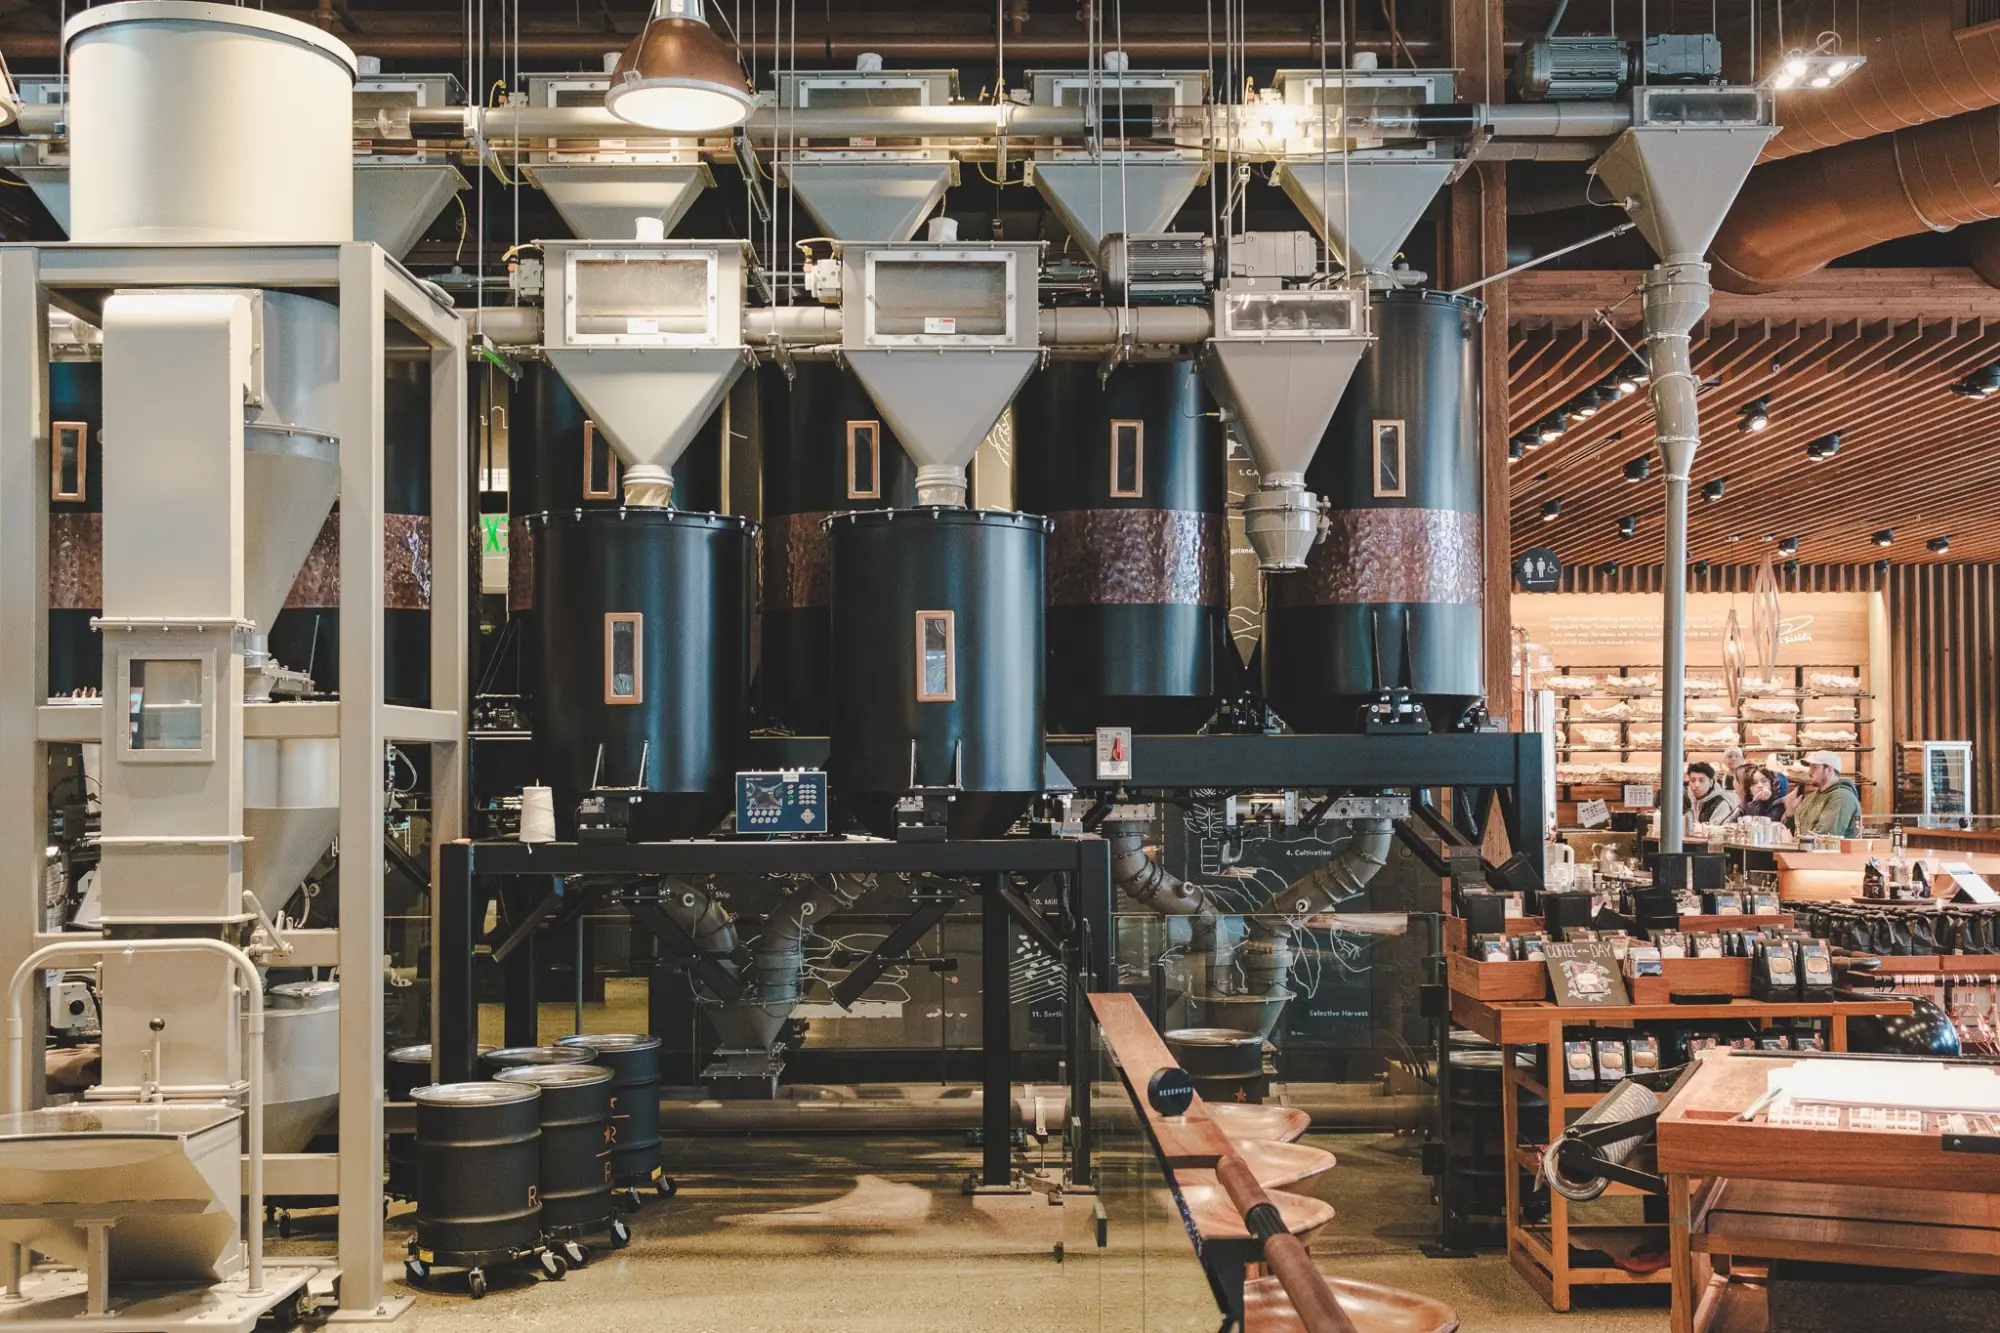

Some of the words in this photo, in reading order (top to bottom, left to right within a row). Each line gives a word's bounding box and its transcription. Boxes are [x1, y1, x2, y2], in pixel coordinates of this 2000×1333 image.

[1872, 887, 1879, 895] R
[1545, 943, 1578, 958] COFFEE
[1589, 943, 1612, 958] DAY
[1309, 1009, 1340, 1017] Selective
[1341, 1009, 1369, 1017] Harvest
[1159, 1086, 1192, 1097] RESERVED
[528, 1185, 537, 1207] R
